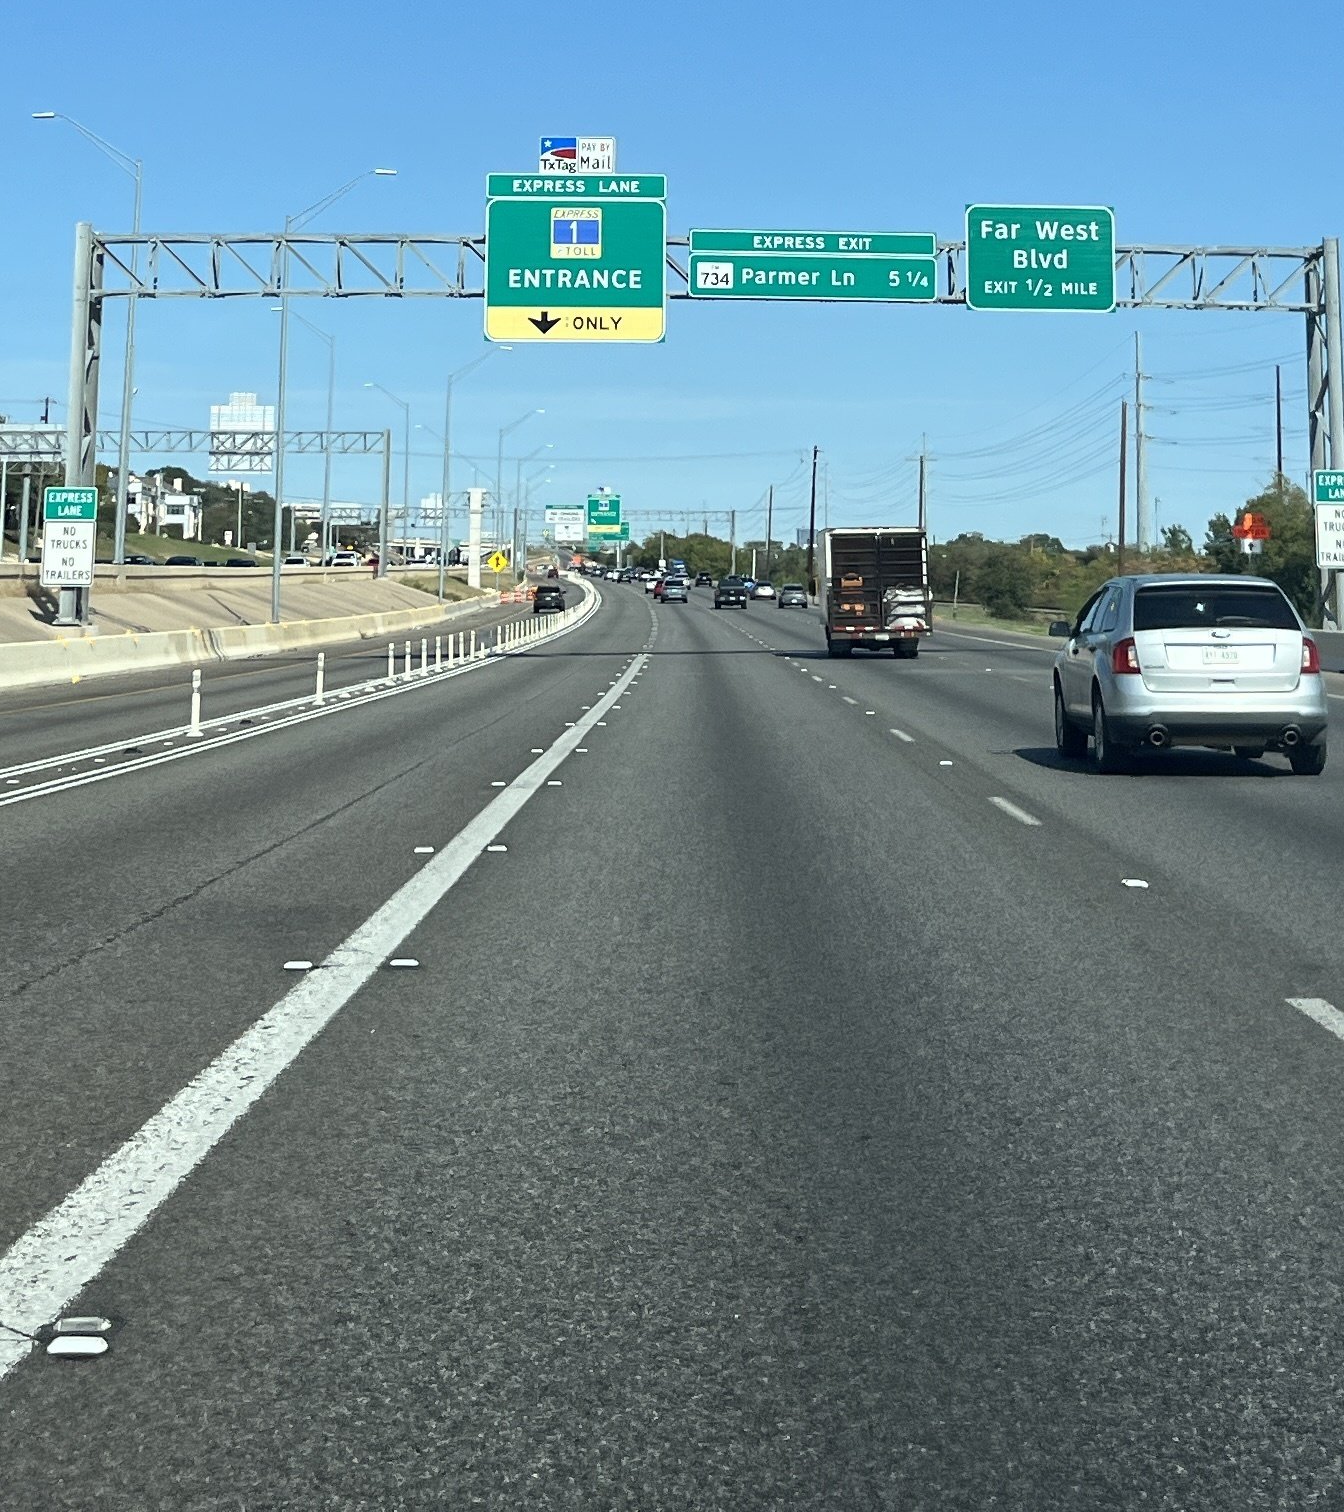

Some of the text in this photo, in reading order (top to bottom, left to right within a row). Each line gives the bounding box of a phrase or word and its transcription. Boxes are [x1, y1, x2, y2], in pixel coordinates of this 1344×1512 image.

[581, 142, 611, 151] PAY BY
[540, 158, 577, 174] TxTag
[580, 156, 611, 170] Mail
[512, 179, 641, 193] EXPRESS LANE
[553, 209, 599, 219] EXPRESS
[569, 220, 578, 244] 1
[980, 220, 1099, 241] Far West
[753, 236, 873, 250] EXPRESS EXIT
[565, 246, 596, 256] TOLL
[1013, 248, 1068, 269] Blvd
[508, 268, 642, 289] ENTRANCE
[700, 272, 730, 286] 734
[741, 268, 820, 286] Parmer
[831, 269, 855, 286] Ln
[888, 270, 900, 287] 5
[984, 280, 1018, 294] EXIT
[1061, 282, 1098, 295] MILE
[572, 316, 623, 330] ONLY
[48, 492, 93, 503] EXPRESS
[57, 505, 83, 516] LANE
[63, 526, 76, 536] NO
[50, 539, 88, 549] TRUCKS
[61, 557, 75, 567] NO
[45, 570, 91, 580] TRAILERS
